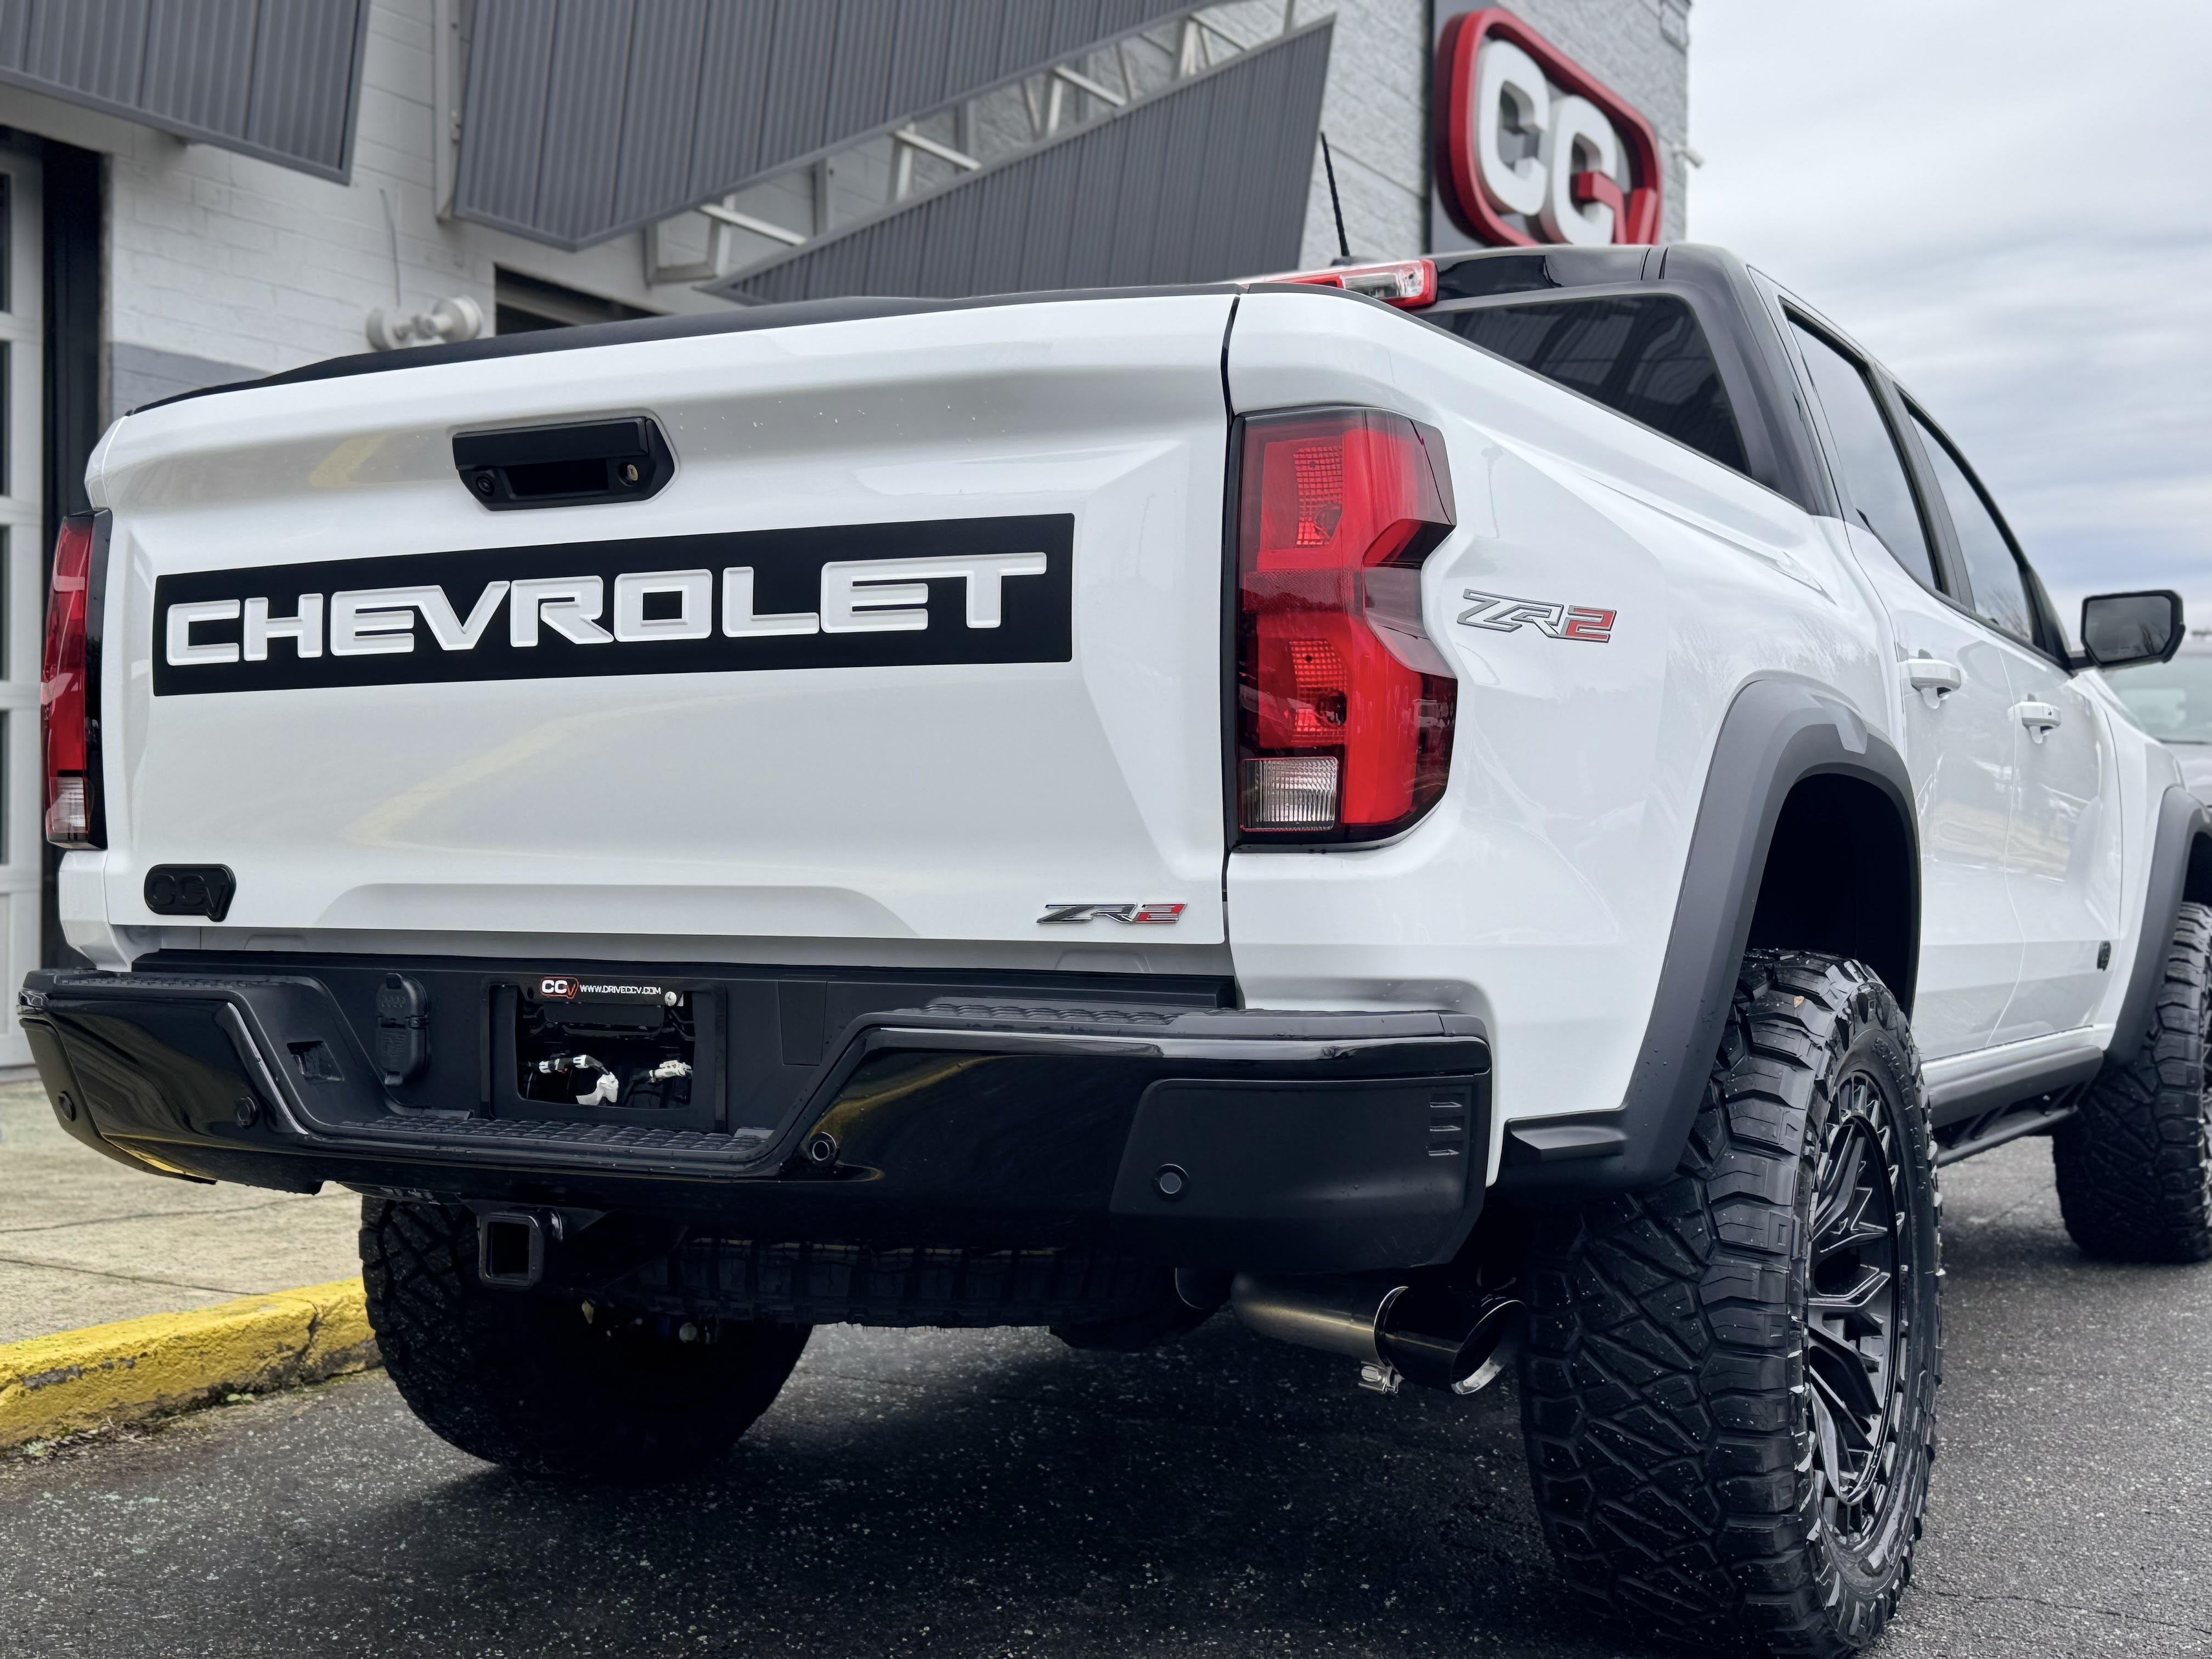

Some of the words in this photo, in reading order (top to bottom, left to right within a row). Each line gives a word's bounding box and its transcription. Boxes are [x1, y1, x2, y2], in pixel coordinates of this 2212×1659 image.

[166, 551, 1047, 665] CHEVROLET
[1457, 588, 1617, 644] ZR2
[1036, 902, 1188, 924] ZR2
[541, 980, 576, 996] CCV
